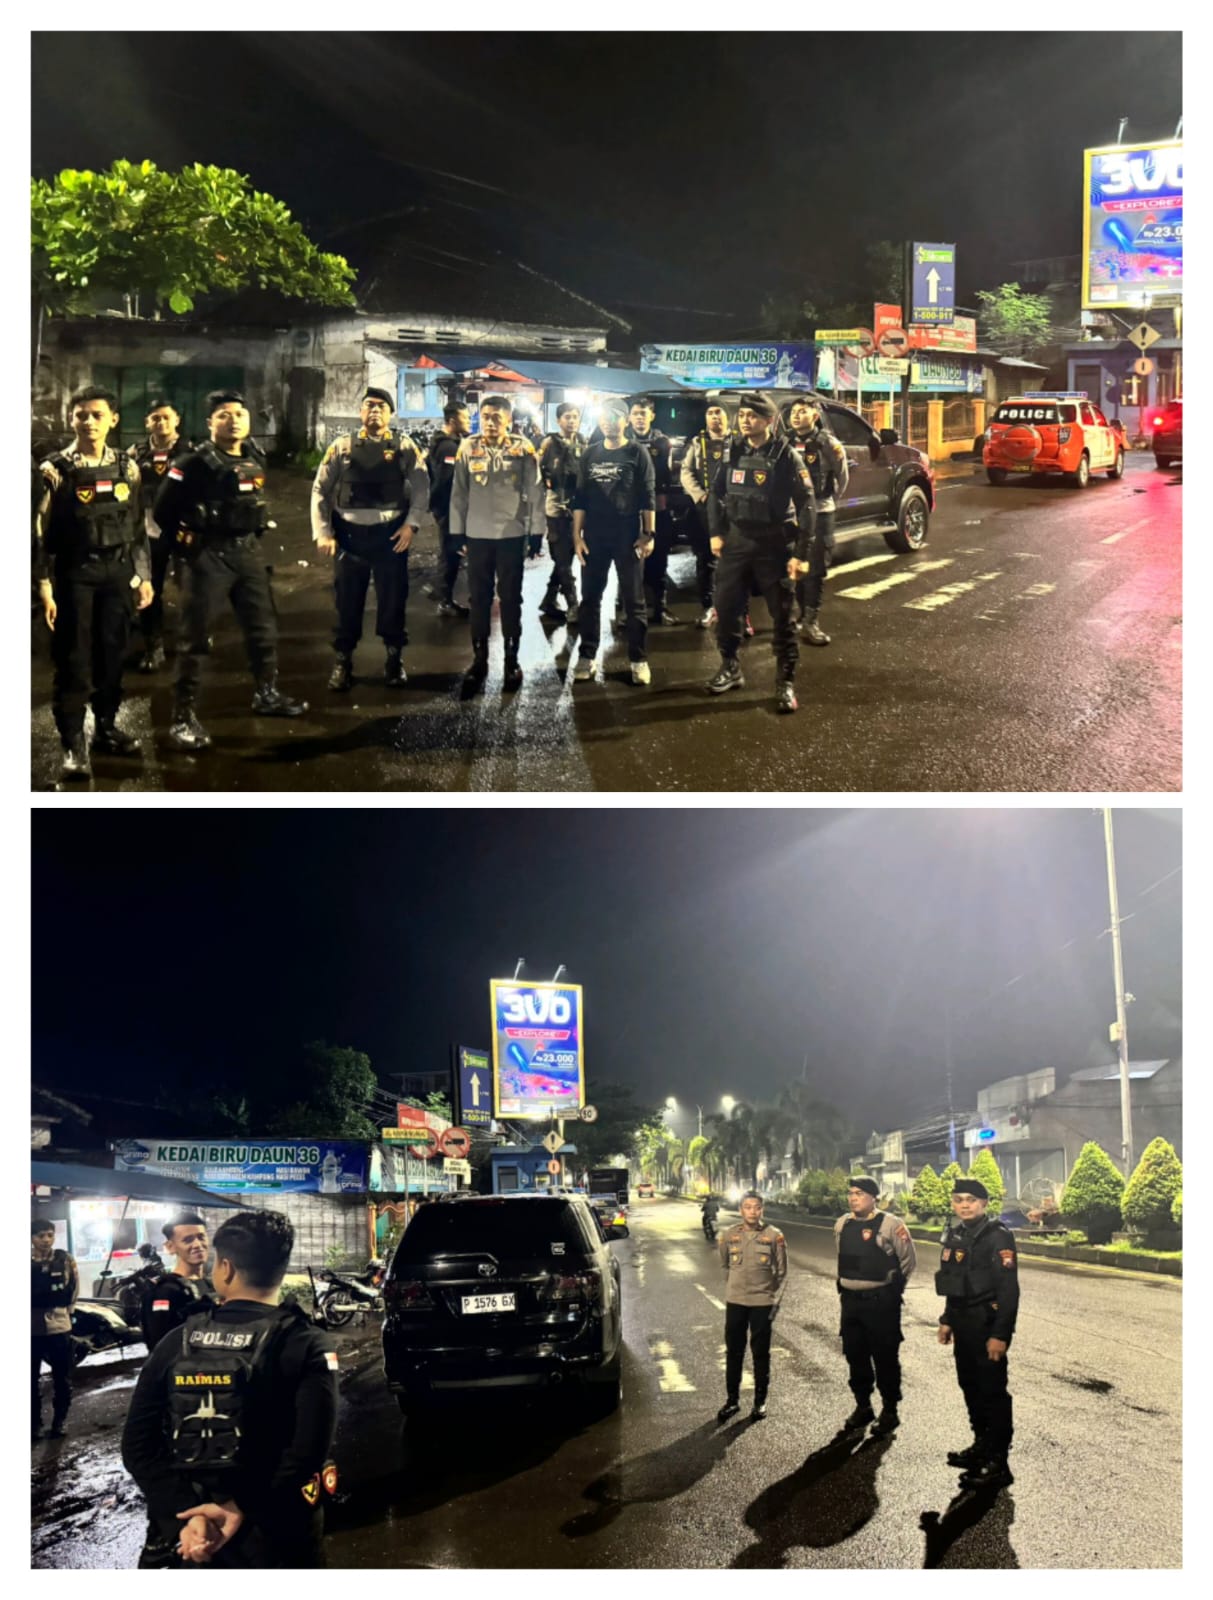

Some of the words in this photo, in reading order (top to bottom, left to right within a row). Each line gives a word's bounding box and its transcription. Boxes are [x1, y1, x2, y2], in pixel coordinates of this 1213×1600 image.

[665, 348, 698, 363] KEDAI
[699, 348, 726, 363] BIRU
[727, 348, 760, 364] DAUN
[761, 348, 777, 364] 36
[999, 409, 1055, 419] POLICE
[156, 1146, 206, 1163] KEDAI
[208, 1146, 249, 1164] BIRU
[250, 1146, 297, 1164] DAUN
[299, 1146, 320, 1164] 36
[463, 1298, 470, 1307] P
[474, 1295, 498, 1309] 1576
[501, 1293, 516, 1307] GX
[189, 1330, 254, 1347] POLISI
[175, 1374, 232, 1385] RAIMAS
